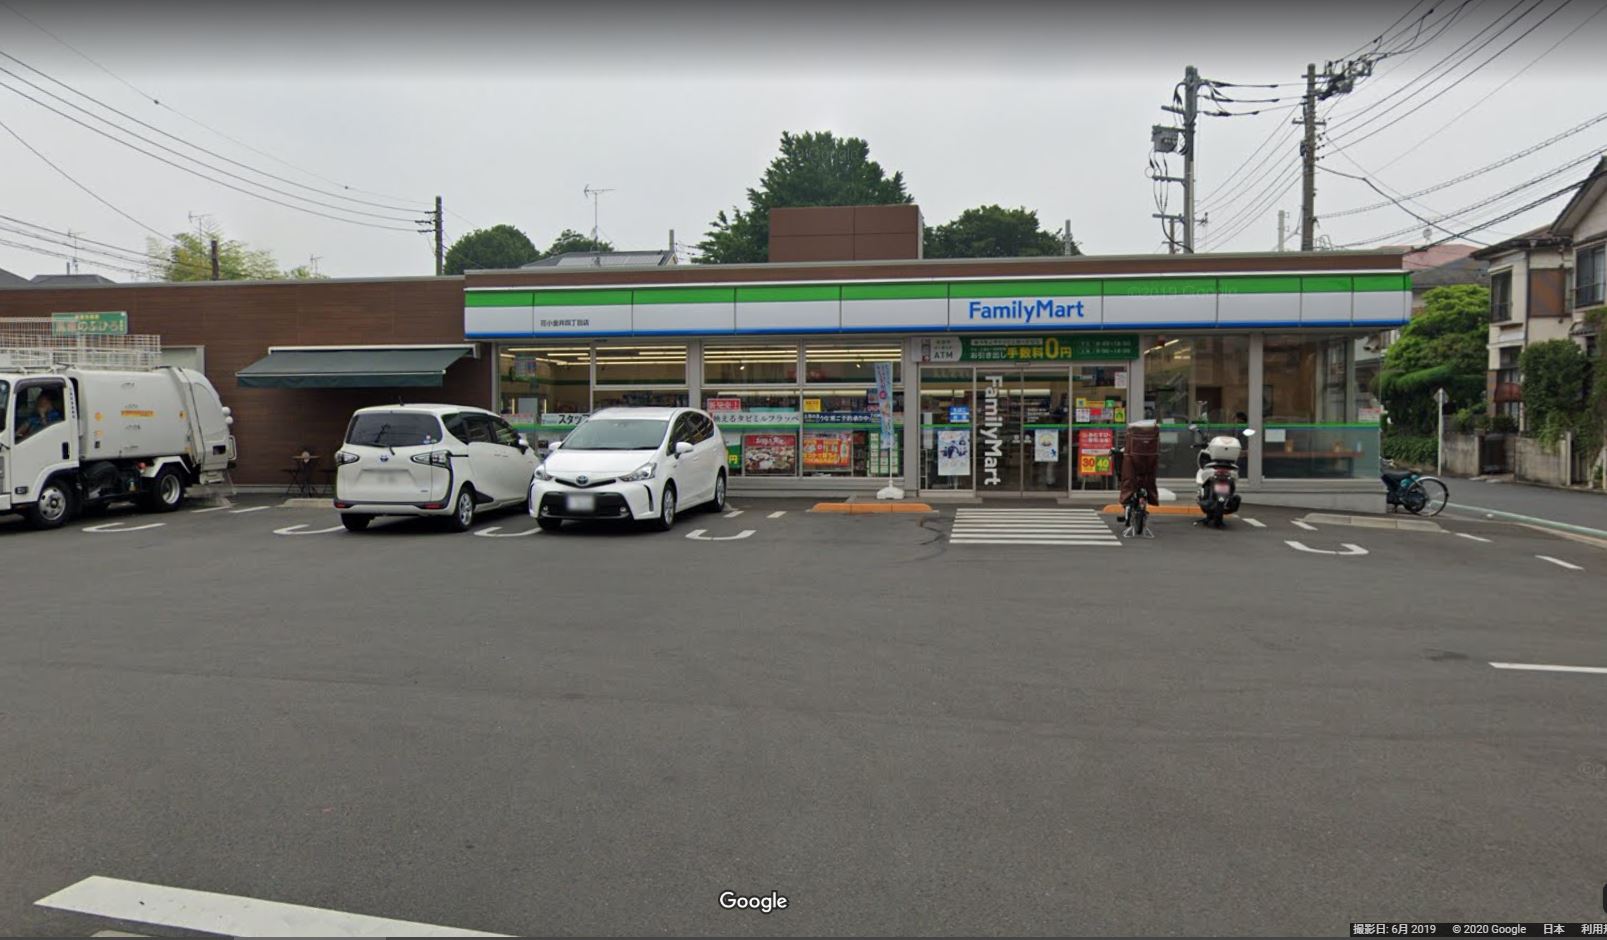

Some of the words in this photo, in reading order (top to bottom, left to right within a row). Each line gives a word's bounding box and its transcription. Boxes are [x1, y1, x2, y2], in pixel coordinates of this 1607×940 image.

[968, 299, 1085, 323] FamilyMart
[934, 351, 954, 359] ATM
[980, 375, 1003, 486] FamilyMart
[1082, 458, 1095, 468] 30
[1096, 458, 1109, 468] 40
